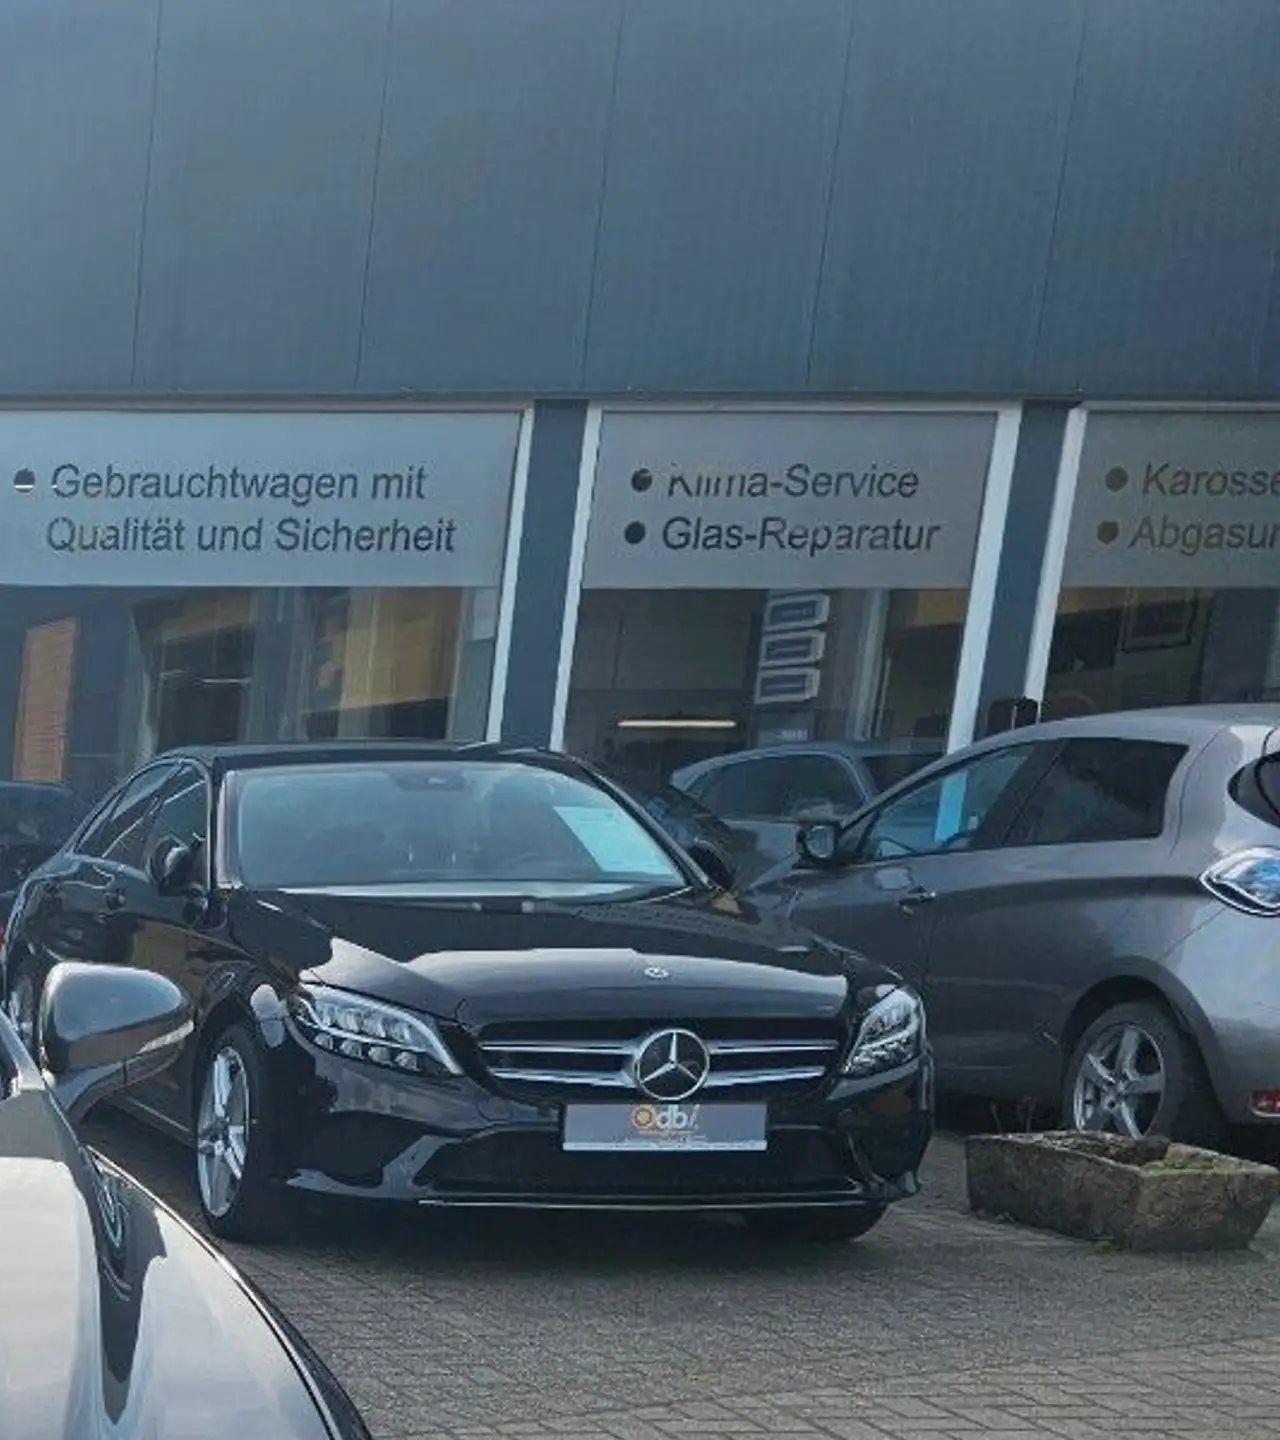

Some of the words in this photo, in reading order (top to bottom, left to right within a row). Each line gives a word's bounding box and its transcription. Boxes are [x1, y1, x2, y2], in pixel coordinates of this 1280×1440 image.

[49, 463, 359, 507] Gebrauchtwagen
[370, 464, 428, 500] mit
[46, 515, 186, 553] Qualität
[196, 517, 264, 553] und
[274, 516, 458, 554] Sicherheit
[661, 515, 941, 557] Glas-Reparatur
